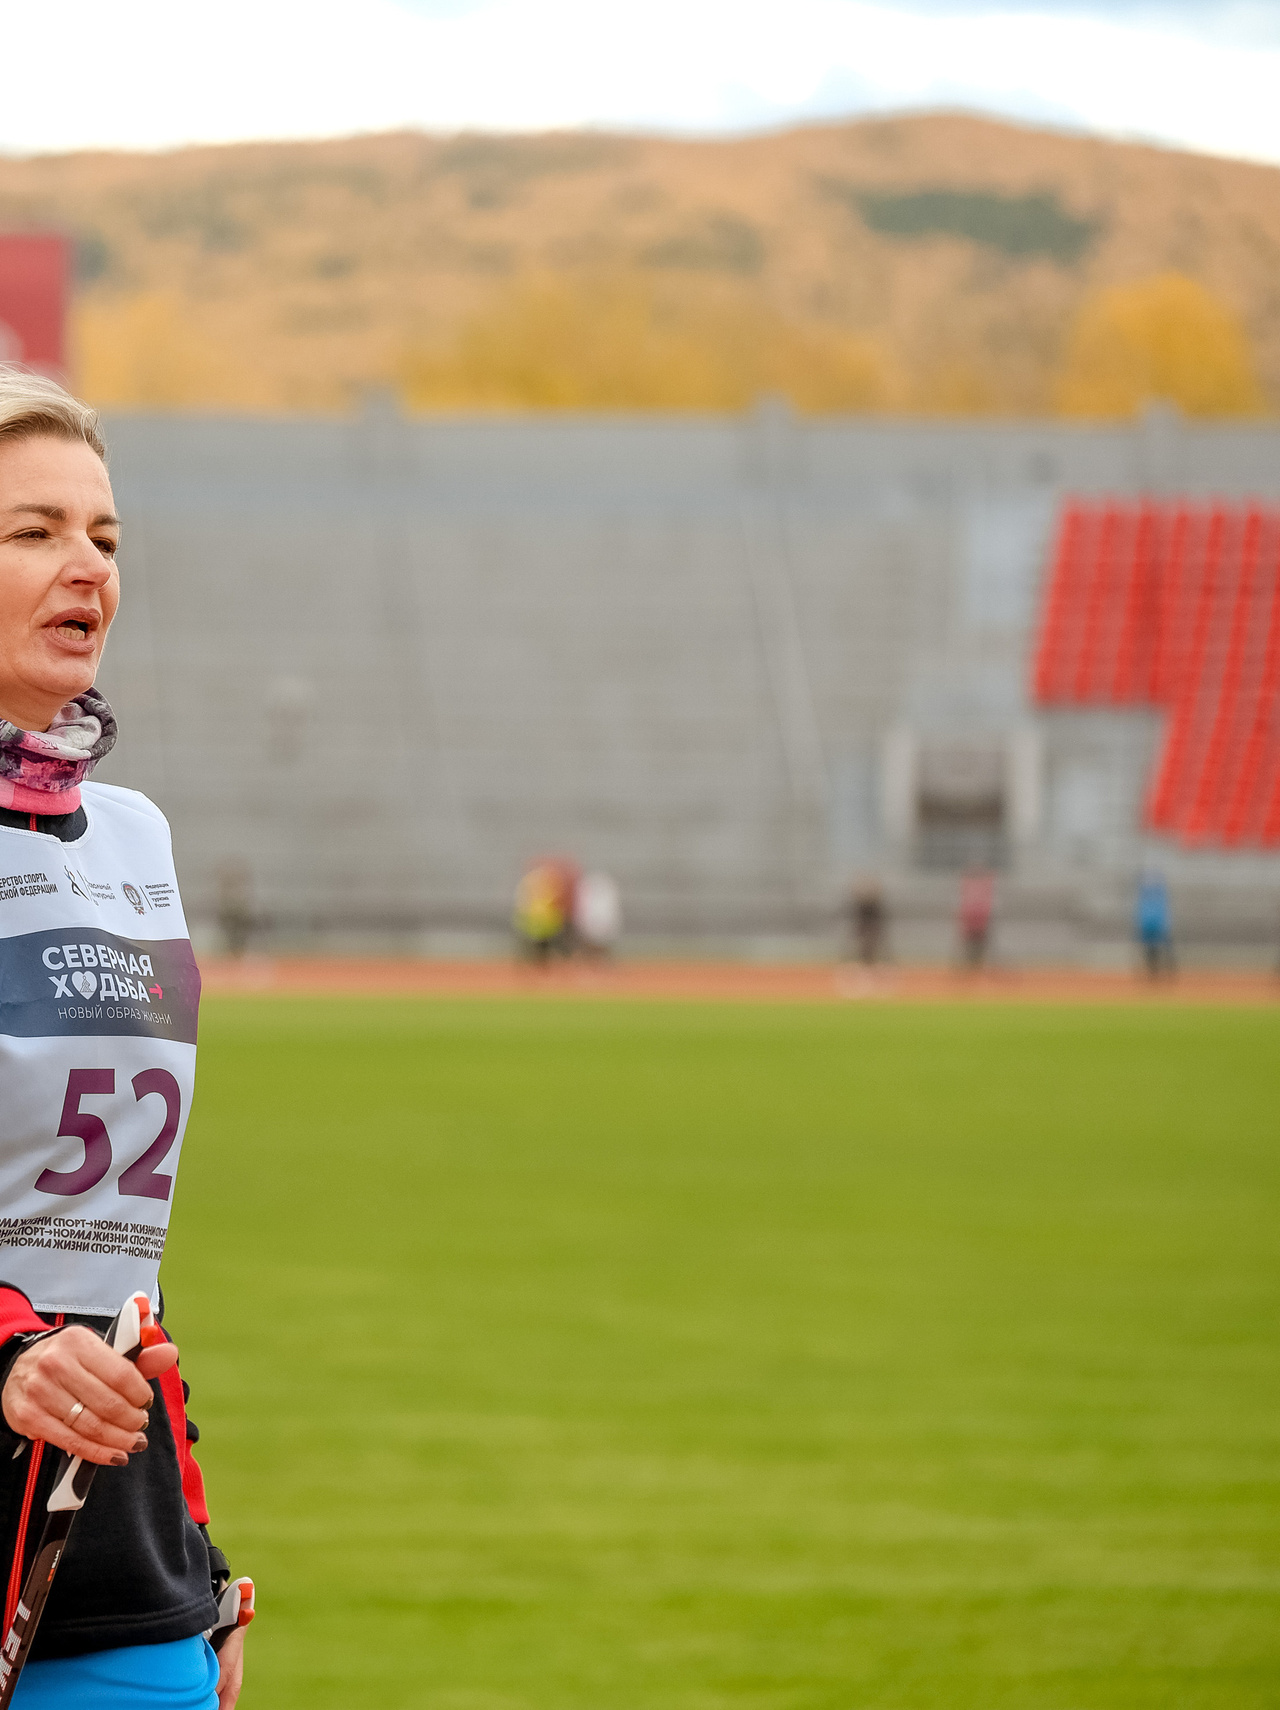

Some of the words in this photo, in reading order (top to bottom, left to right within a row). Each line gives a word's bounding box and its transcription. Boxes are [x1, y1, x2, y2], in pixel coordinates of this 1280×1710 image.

[23, 873, 48, 884] СПОРТА
[20, 883, 59, 897] ФЕДЕРАЦИИ
[42, 944, 154, 977] СЕВЕРНАЯ
[57, 1003, 102, 1019] НОВЫЙ
[106, 1006, 141, 1020] ОБРАЗ
[141, 1009, 173, 1025] ЖИЗНИ
[34, 1068, 181, 1201] 52
[92, 1231, 129, 1244] ЖИЗНИ
[52, 1239, 90, 1252] ЖИЗНИ
